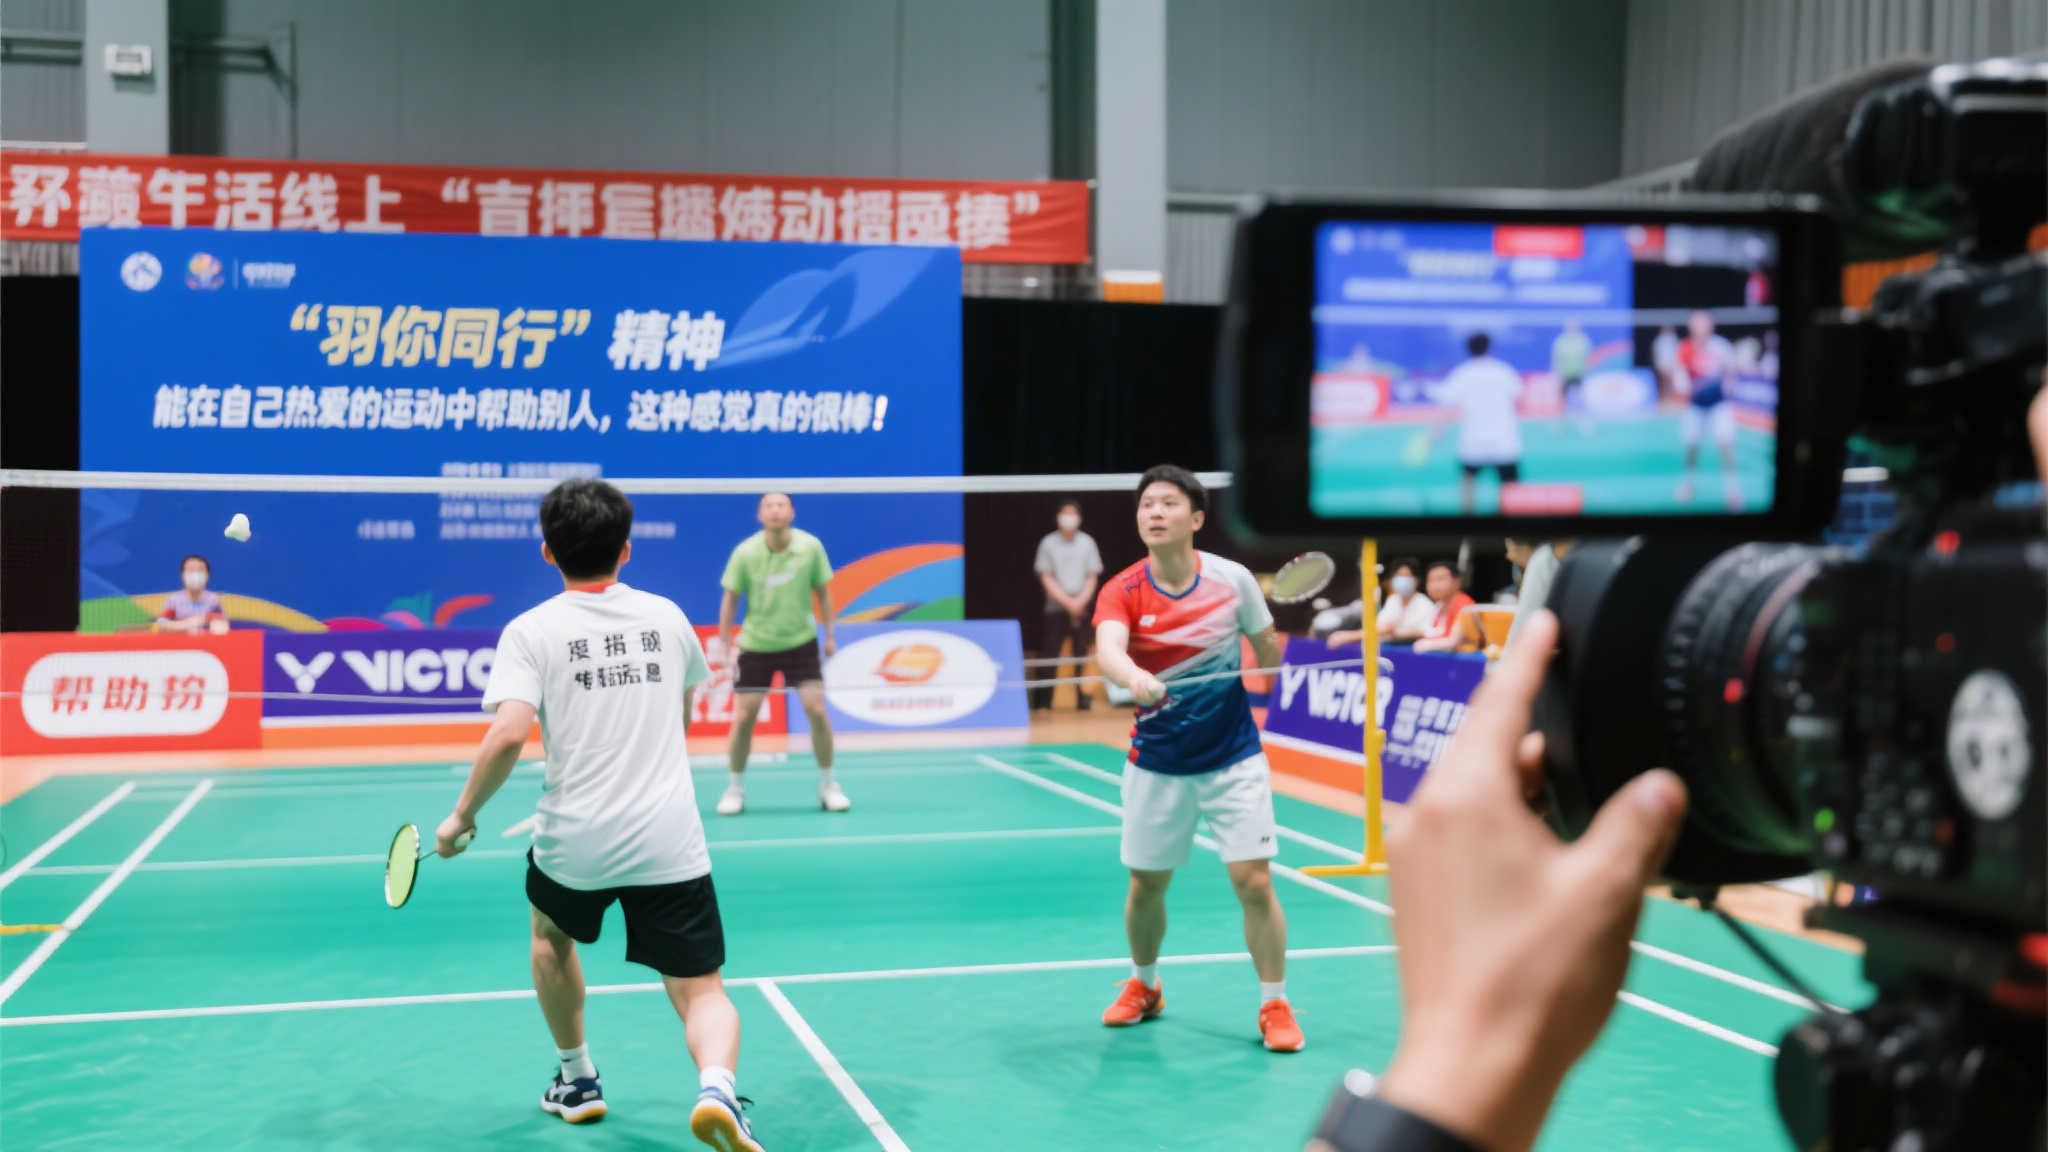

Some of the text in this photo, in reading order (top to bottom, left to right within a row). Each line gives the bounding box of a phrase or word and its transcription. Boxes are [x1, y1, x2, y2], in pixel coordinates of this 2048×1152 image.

[290, 303, 726, 371] “羽你同行” 精神
